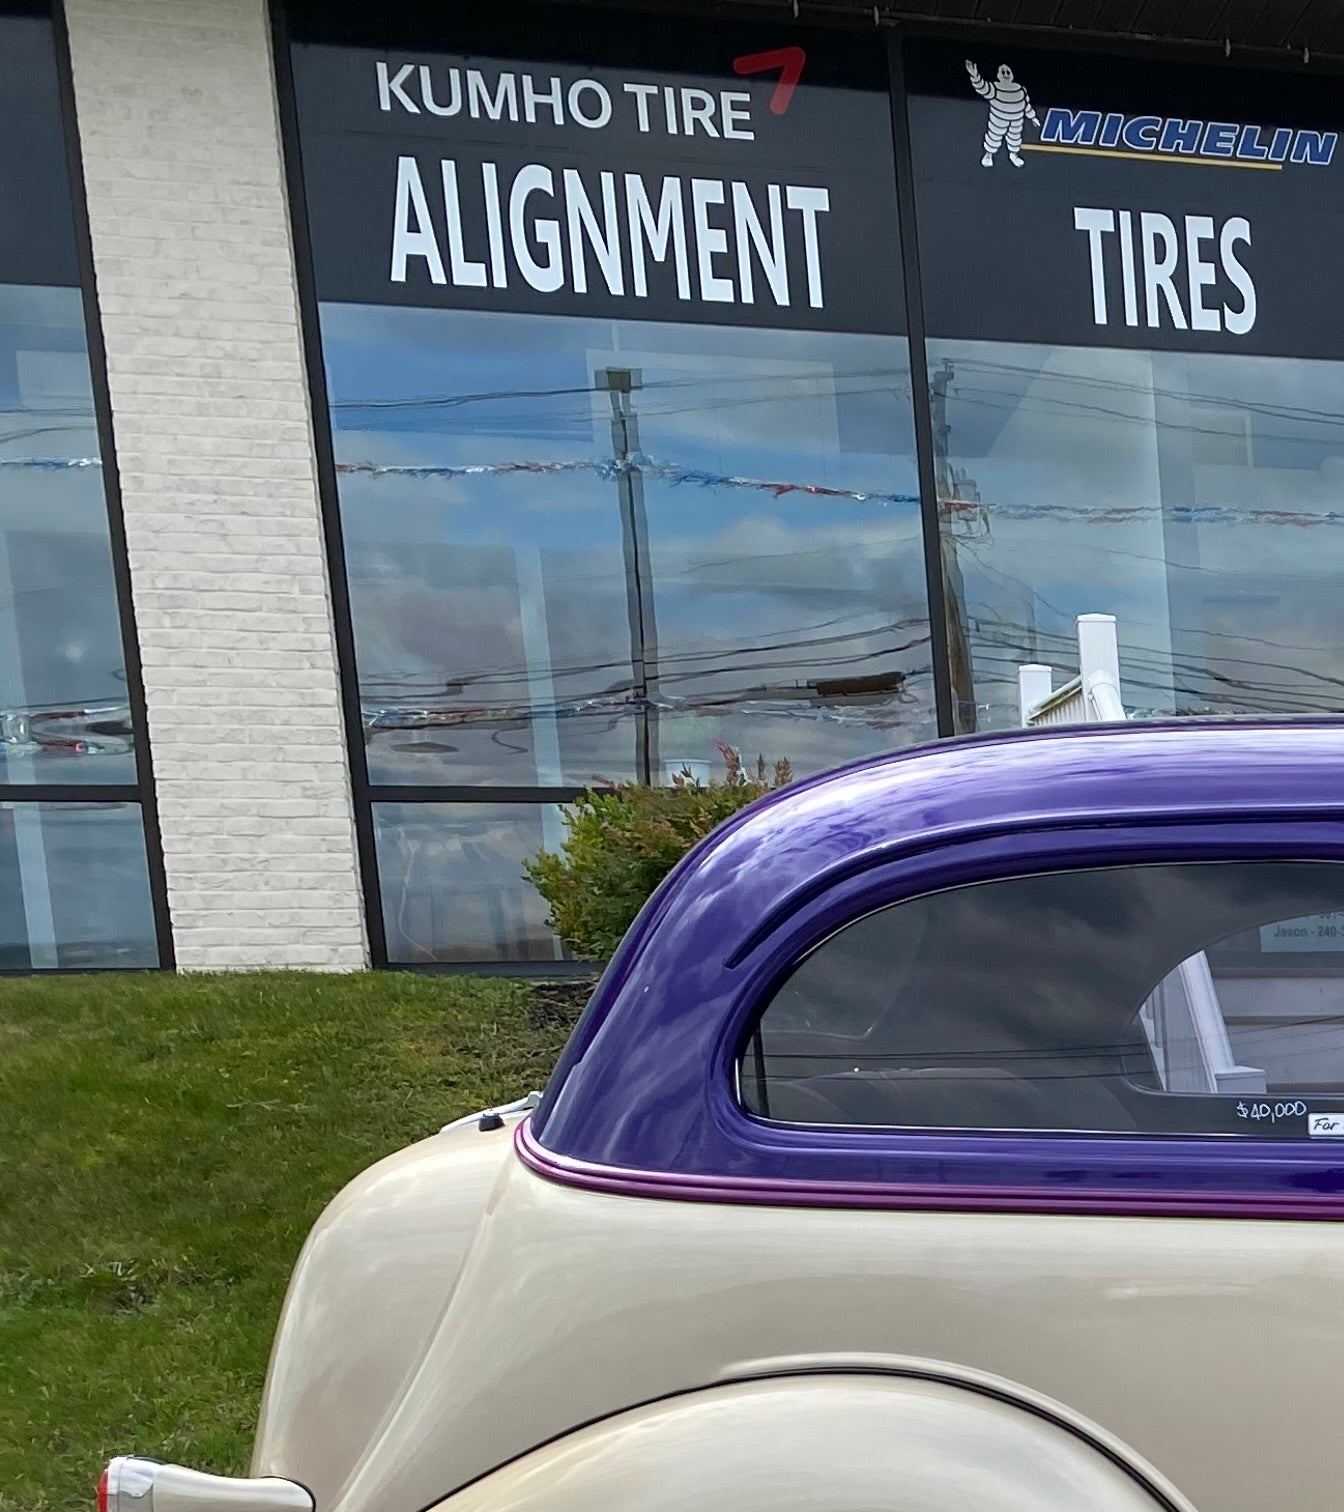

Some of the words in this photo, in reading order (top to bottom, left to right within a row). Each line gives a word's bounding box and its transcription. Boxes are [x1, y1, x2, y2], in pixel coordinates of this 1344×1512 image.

[375, 61, 613, 129] KUMHO
[623, 83, 755, 141] TIRE
[1039, 106, 1340, 167] MICHELIN
[390, 155, 830, 309] ALIGNMENT
[1073, 206, 1257, 335] TIRES
[1236, 1100, 1307, 1123] $40,000
[1313, 1117, 1340, 1132] For
